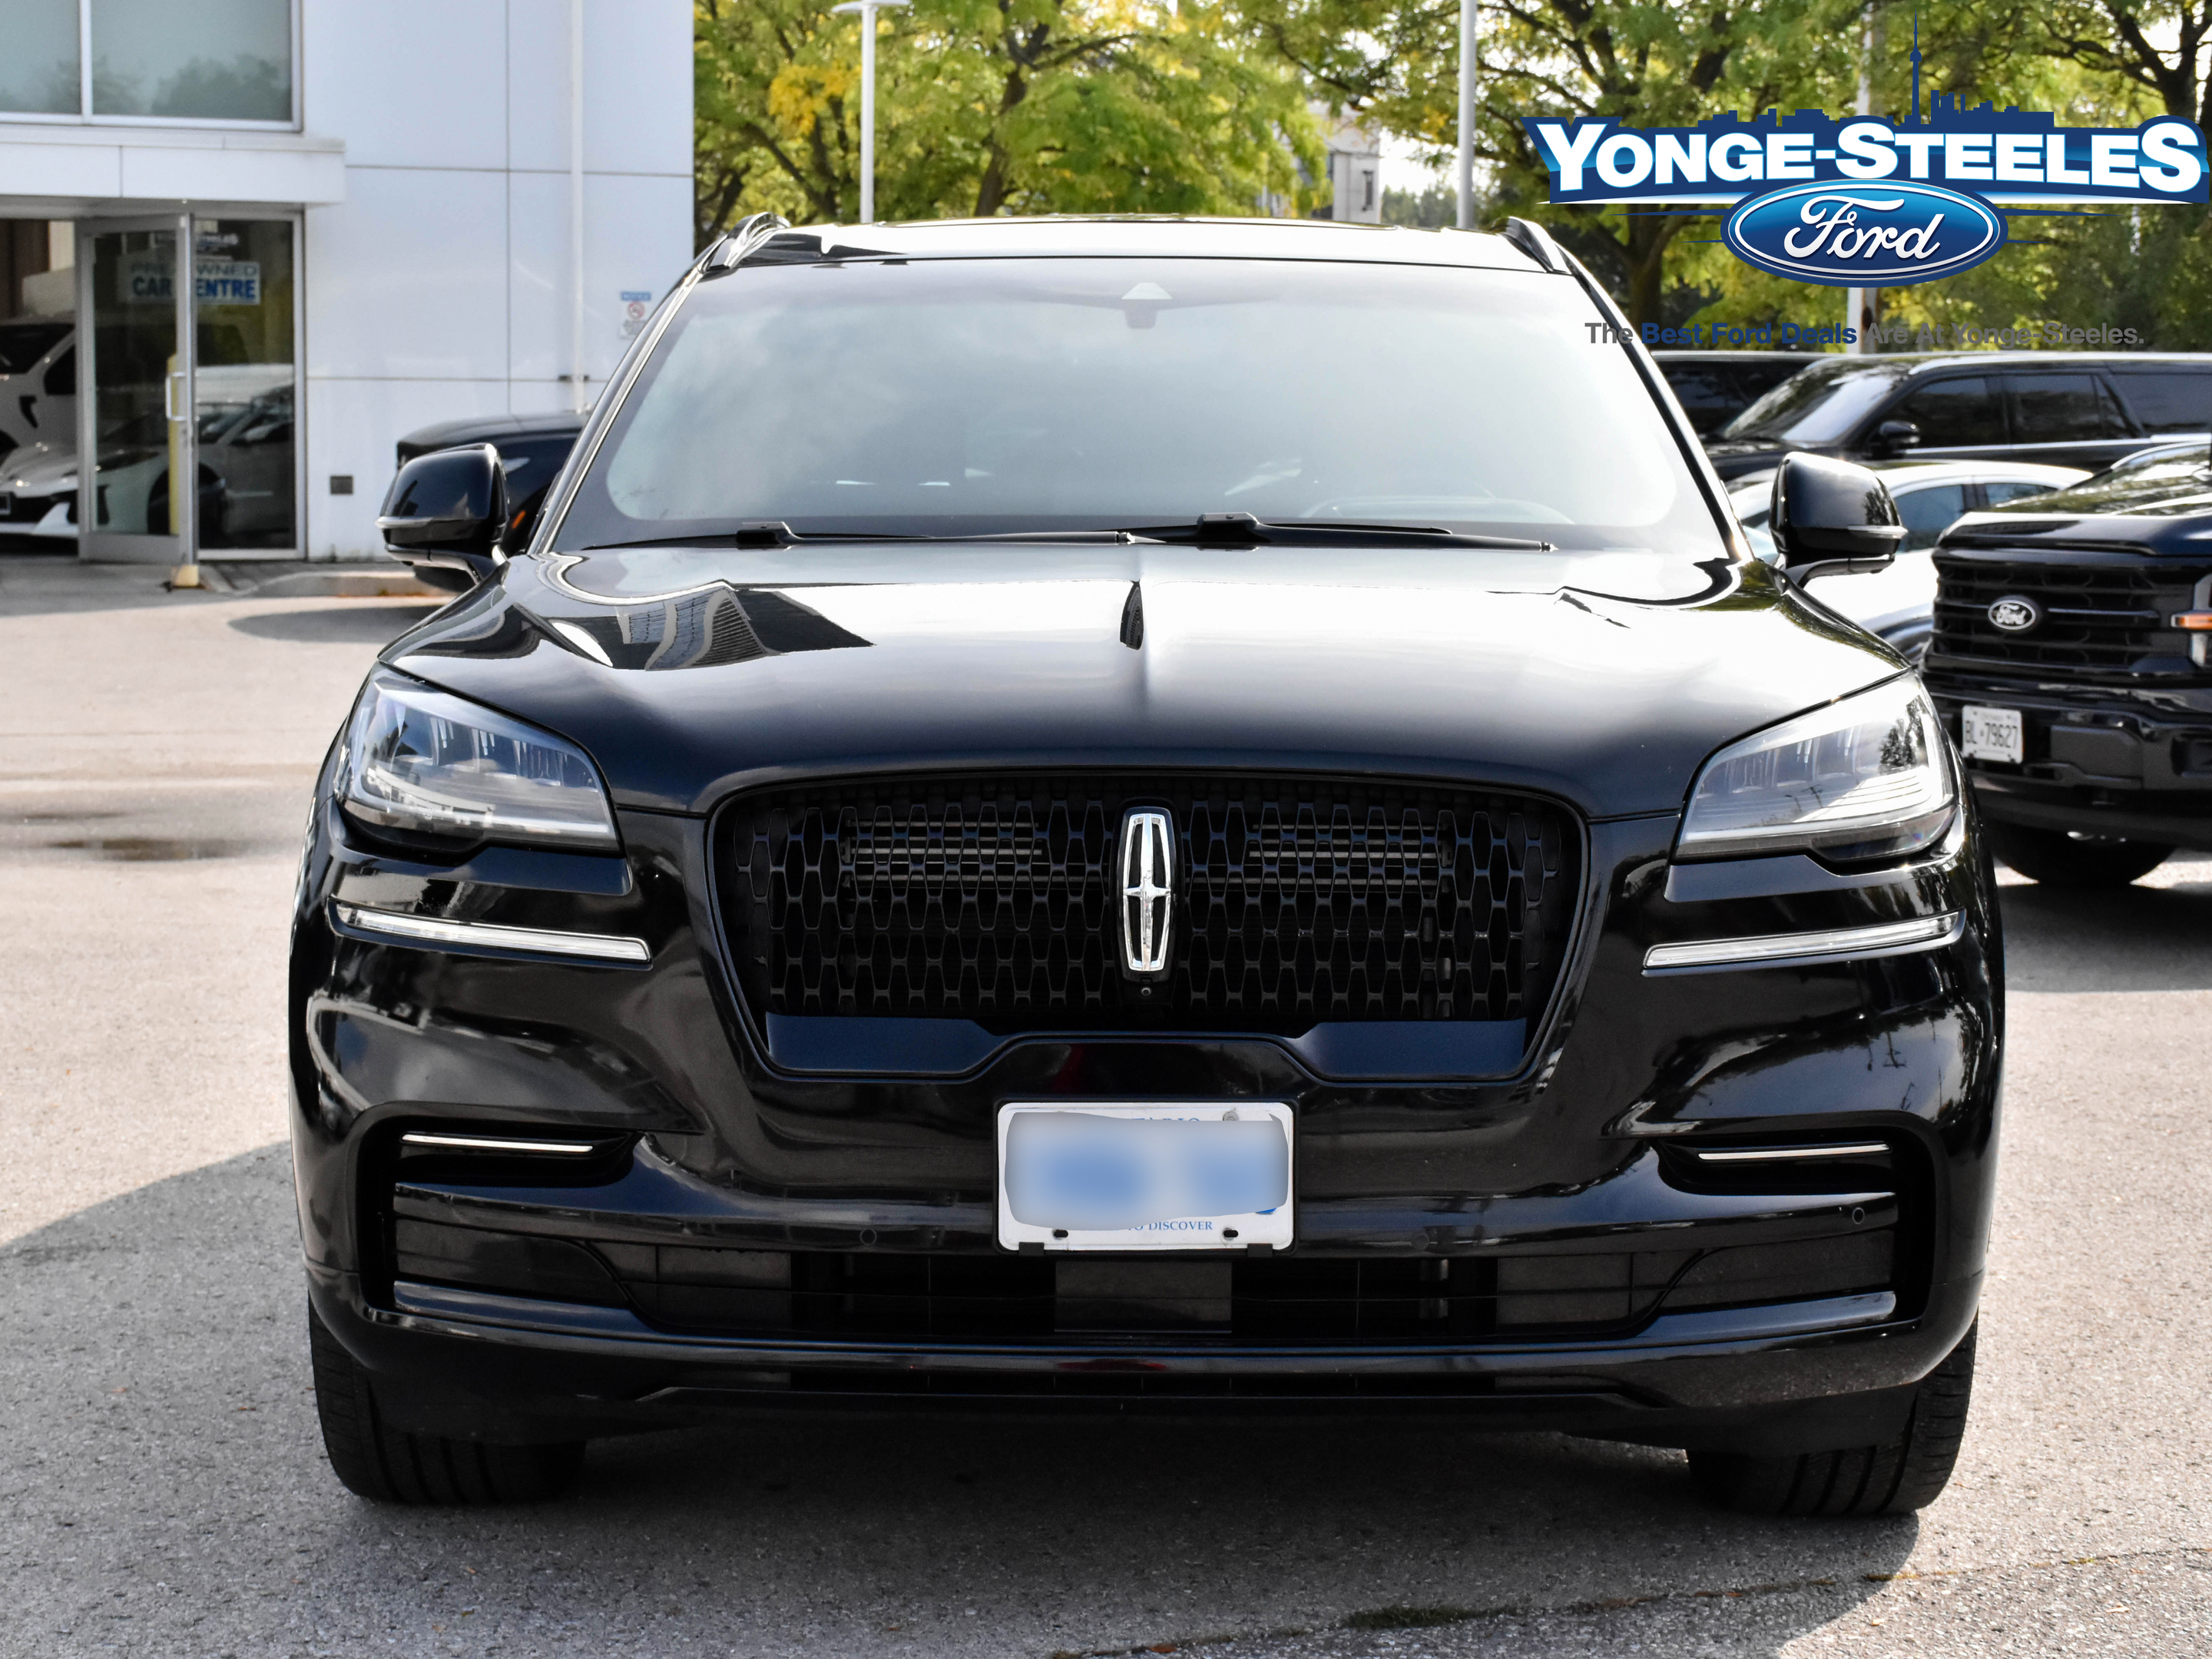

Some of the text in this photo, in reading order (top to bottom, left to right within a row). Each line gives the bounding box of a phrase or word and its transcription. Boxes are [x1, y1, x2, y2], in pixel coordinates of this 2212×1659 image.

[133, 277, 256, 298] CAR ENTRE
[1996, 603, 2026, 624] Ford
[1149, 1220, 1213, 1230] DISCOVER
